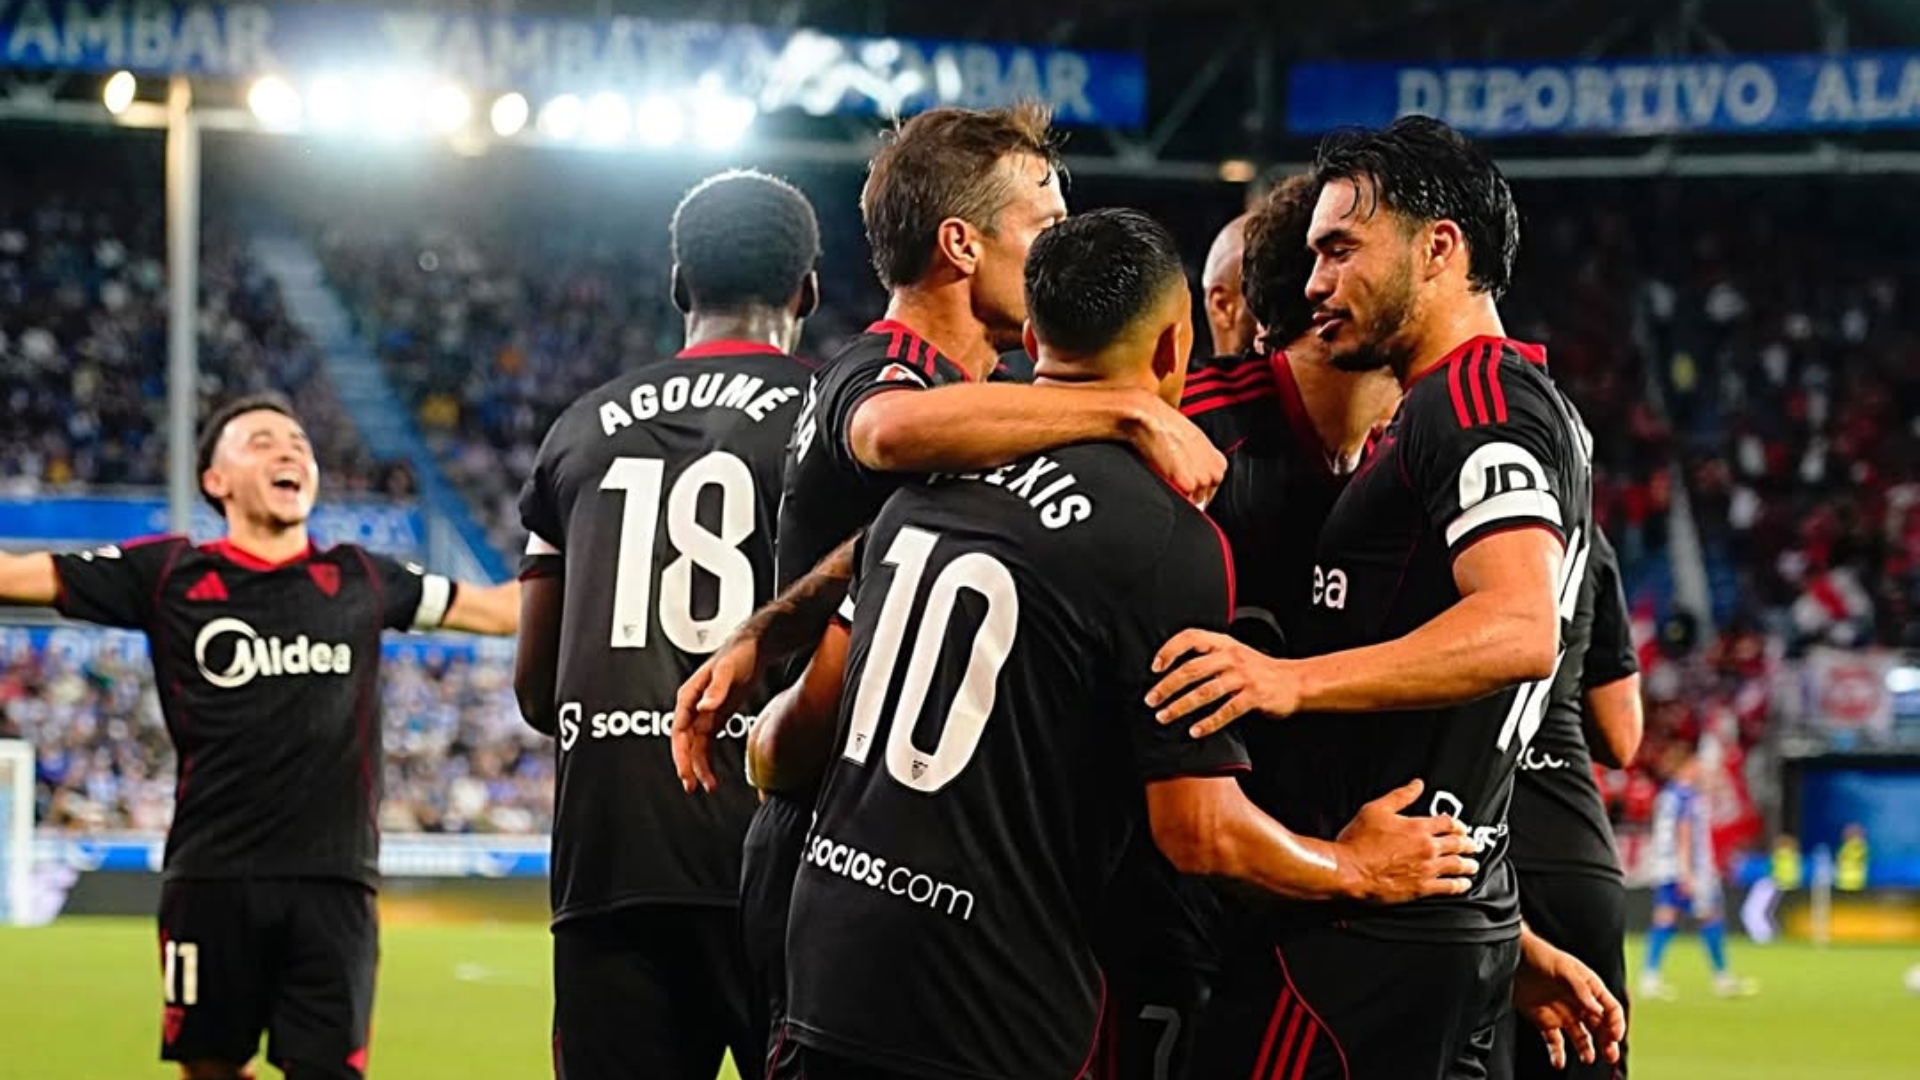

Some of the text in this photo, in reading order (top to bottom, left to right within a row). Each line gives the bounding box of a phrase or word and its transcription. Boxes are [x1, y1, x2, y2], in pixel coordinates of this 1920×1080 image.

[8, 0, 275, 74] AMBAR
[1397, 62, 1777, 134] DEPORTIVO
[599, 372, 799, 436] AGOUMÉ
[1482, 462, 1537, 501] JD
[598, 450, 756, 654] 18
[195, 617, 352, 689] Midea
[841, 525, 1019, 793] 10
[165, 940, 198, 1005] 11
